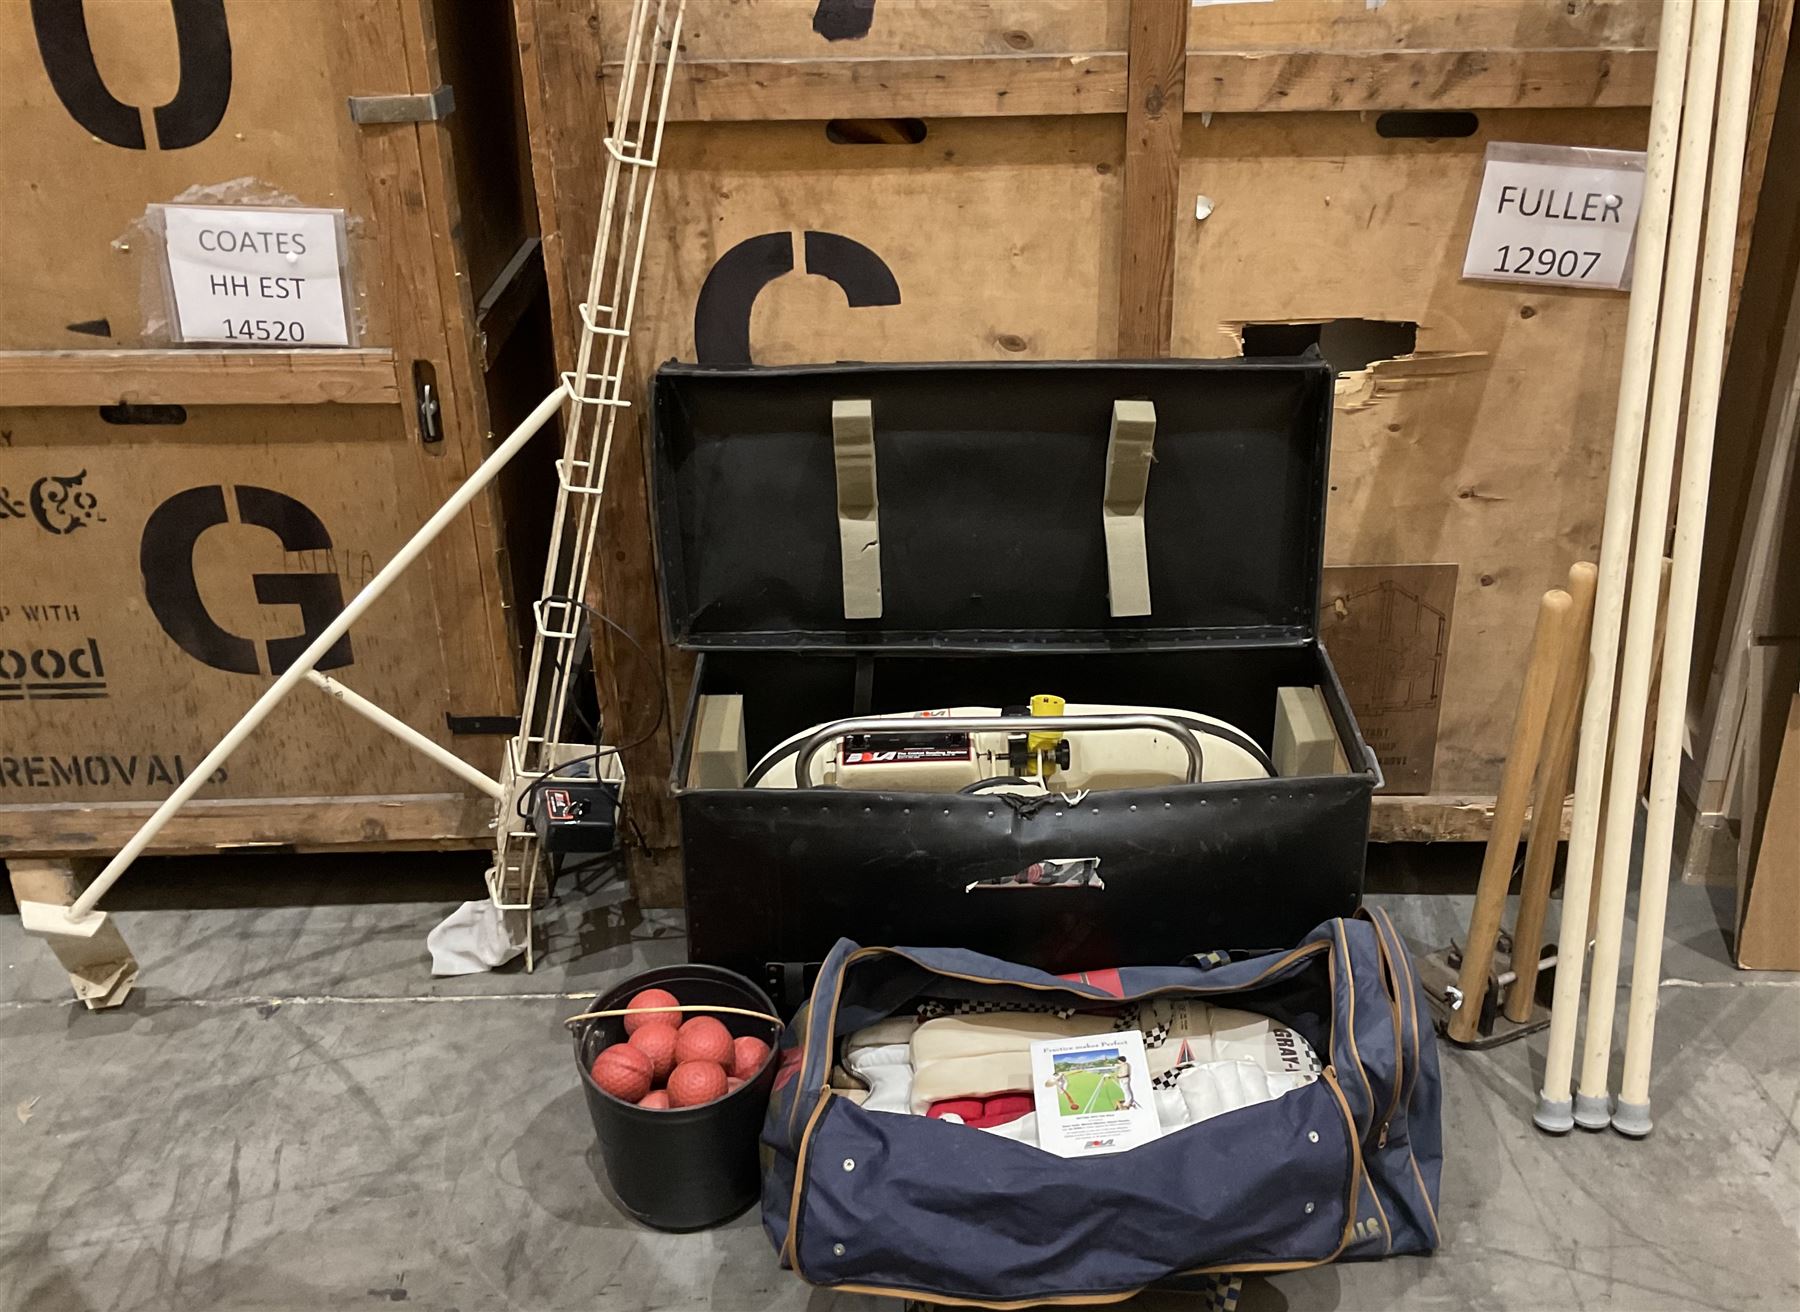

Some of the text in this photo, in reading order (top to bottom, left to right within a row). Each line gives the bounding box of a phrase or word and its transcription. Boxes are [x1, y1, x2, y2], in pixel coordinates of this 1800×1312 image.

[1498, 186, 1623, 223] FULLER
[198, 229, 306, 255] COATES
[1493, 245, 1602, 279] 12907
[210, 274, 306, 299] HH EST
[222, 318, 305, 342] 14520
[140, 484, 355, 677] G
[21, 604, 80, 621] WITH
[846, 751, 897, 762] BOLA
